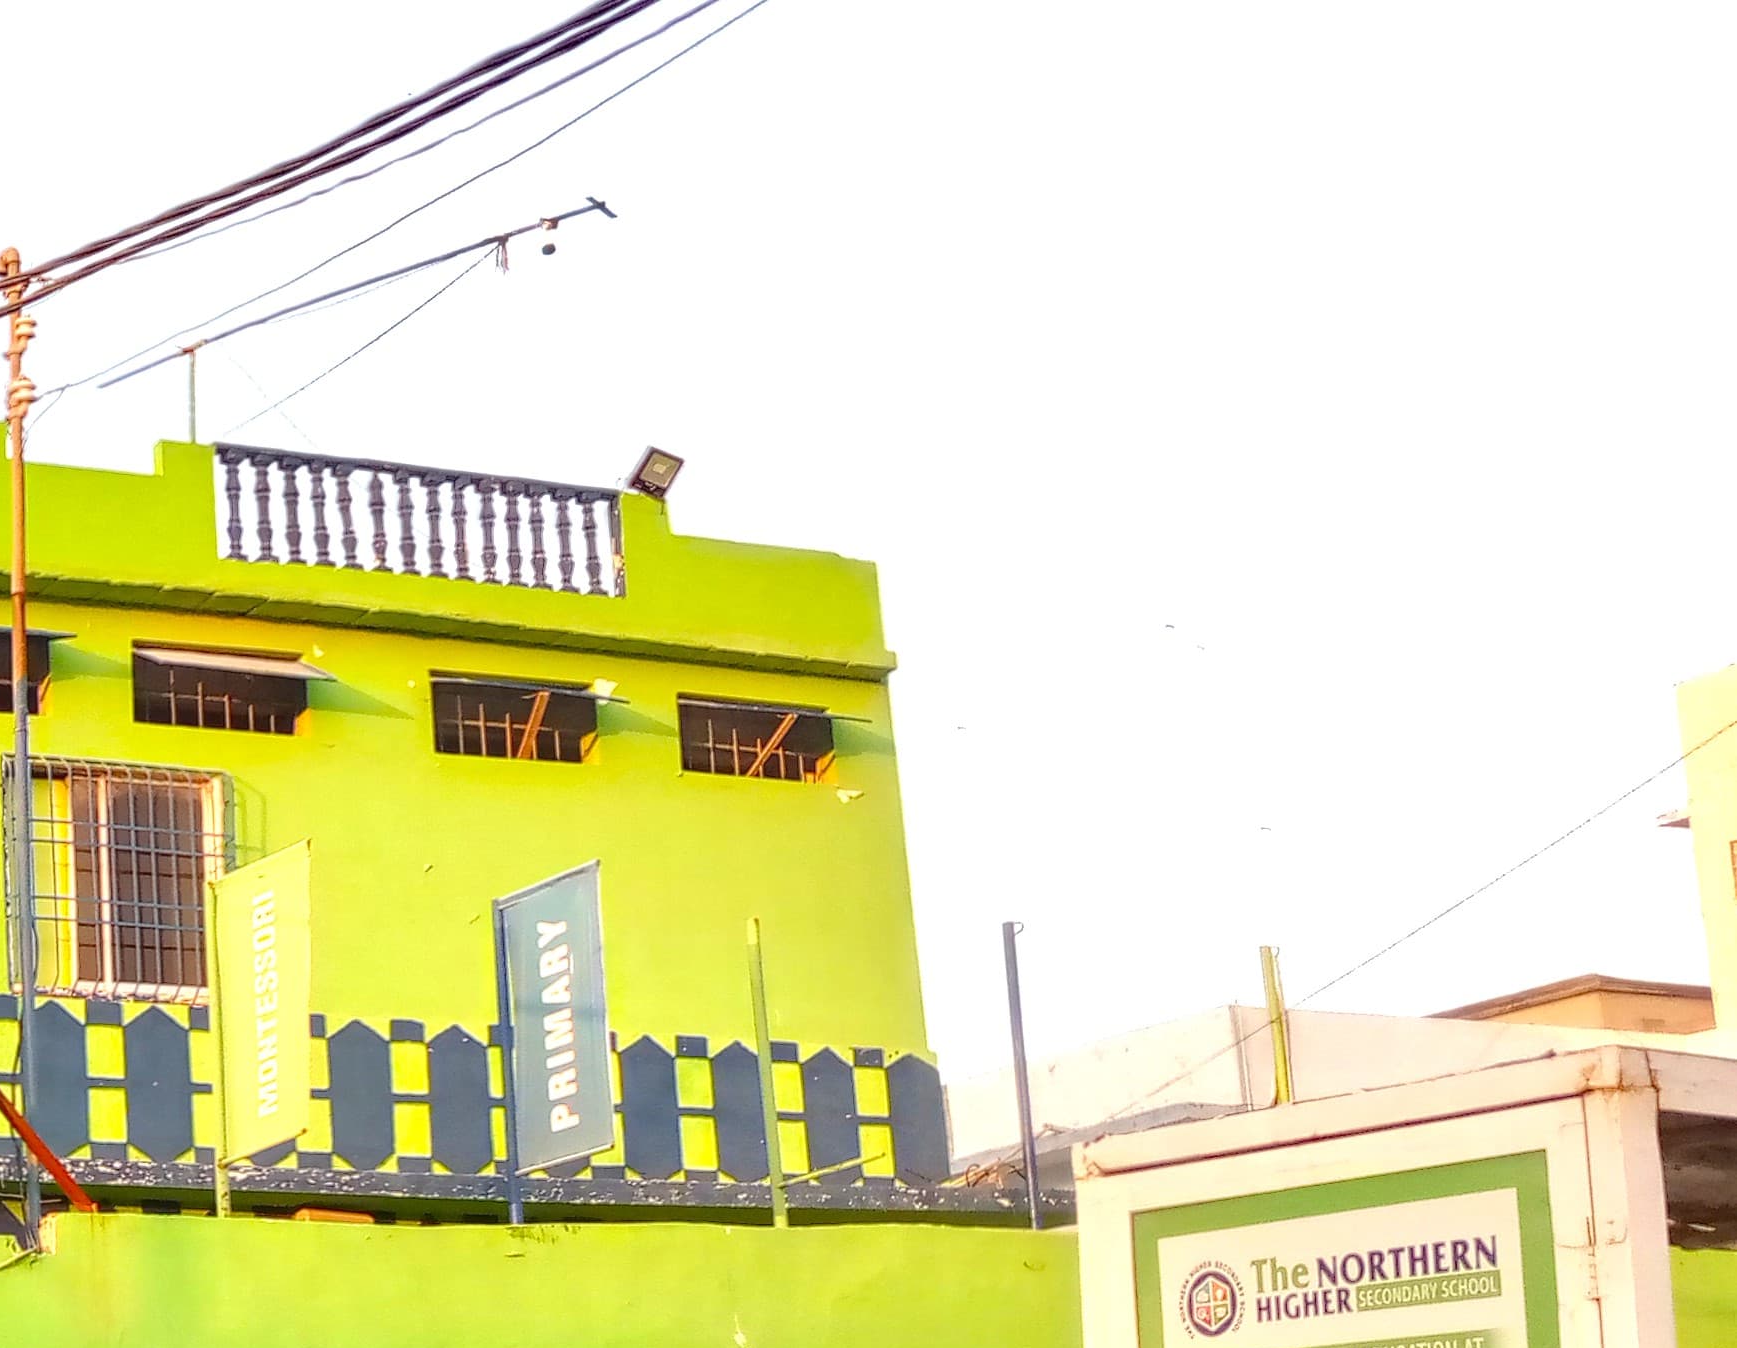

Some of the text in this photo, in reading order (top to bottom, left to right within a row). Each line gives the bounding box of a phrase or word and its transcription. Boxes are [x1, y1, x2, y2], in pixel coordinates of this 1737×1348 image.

[251, 888, 280, 1119] MONTESSORI
[536, 918, 581, 1133] PRIMARY
[1250, 1235, 1497, 1293] The NORTHERN
[1256, 1276, 1497, 1323] HIGHER SECONDARY SCHOOL
